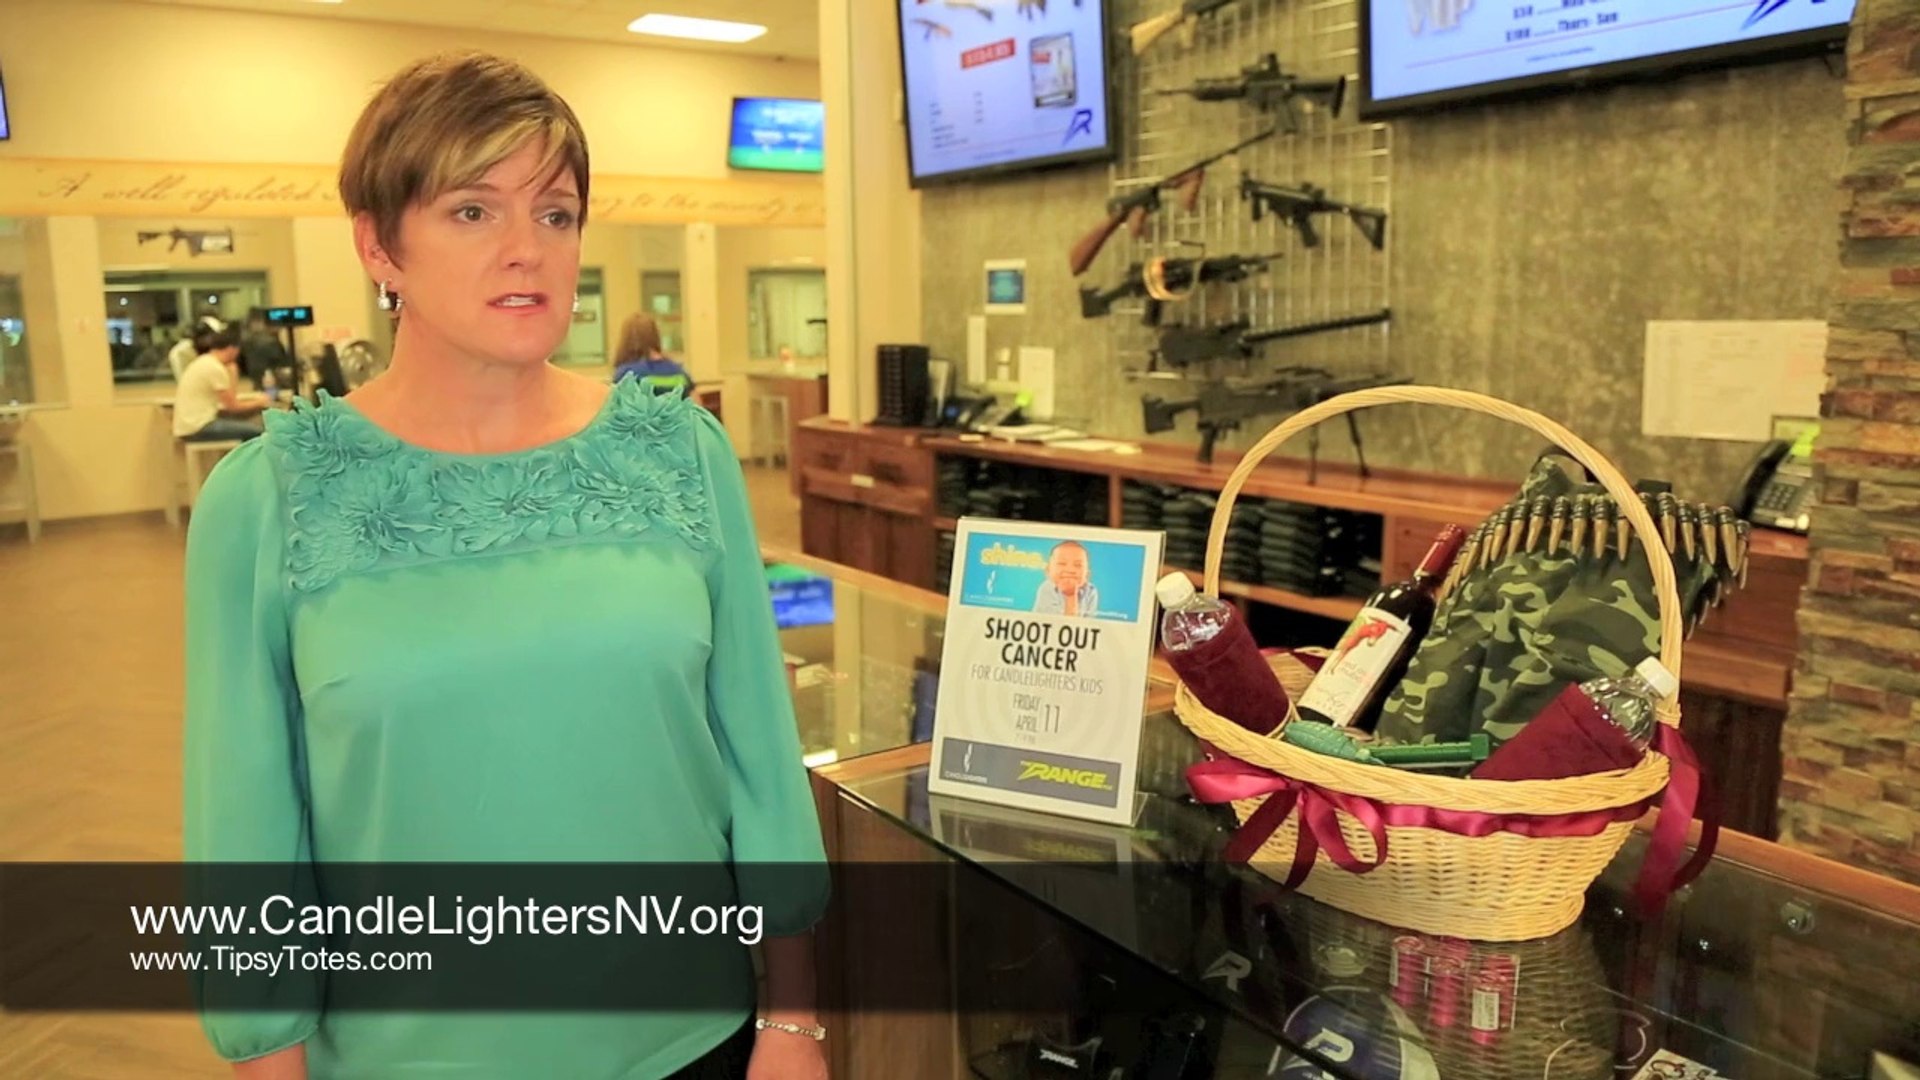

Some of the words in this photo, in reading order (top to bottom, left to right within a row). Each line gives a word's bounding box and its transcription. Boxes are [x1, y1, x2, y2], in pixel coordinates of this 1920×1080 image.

[985, 617, 1052, 645] SHOOT
[1058, 625, 1101, 650] OUT
[1001, 643, 1078, 672] CANCER
[971, 664, 991, 681] FOR
[993, 666, 1077, 691] CANDLELIGHTERS
[1079, 678, 1104, 695] KIDS
[1012, 692, 1041, 711] FRIDAY
[1015, 714, 1037, 733] APRIL
[1045, 703, 1060, 734] 11
[1017, 761, 1107, 789] RANGE
